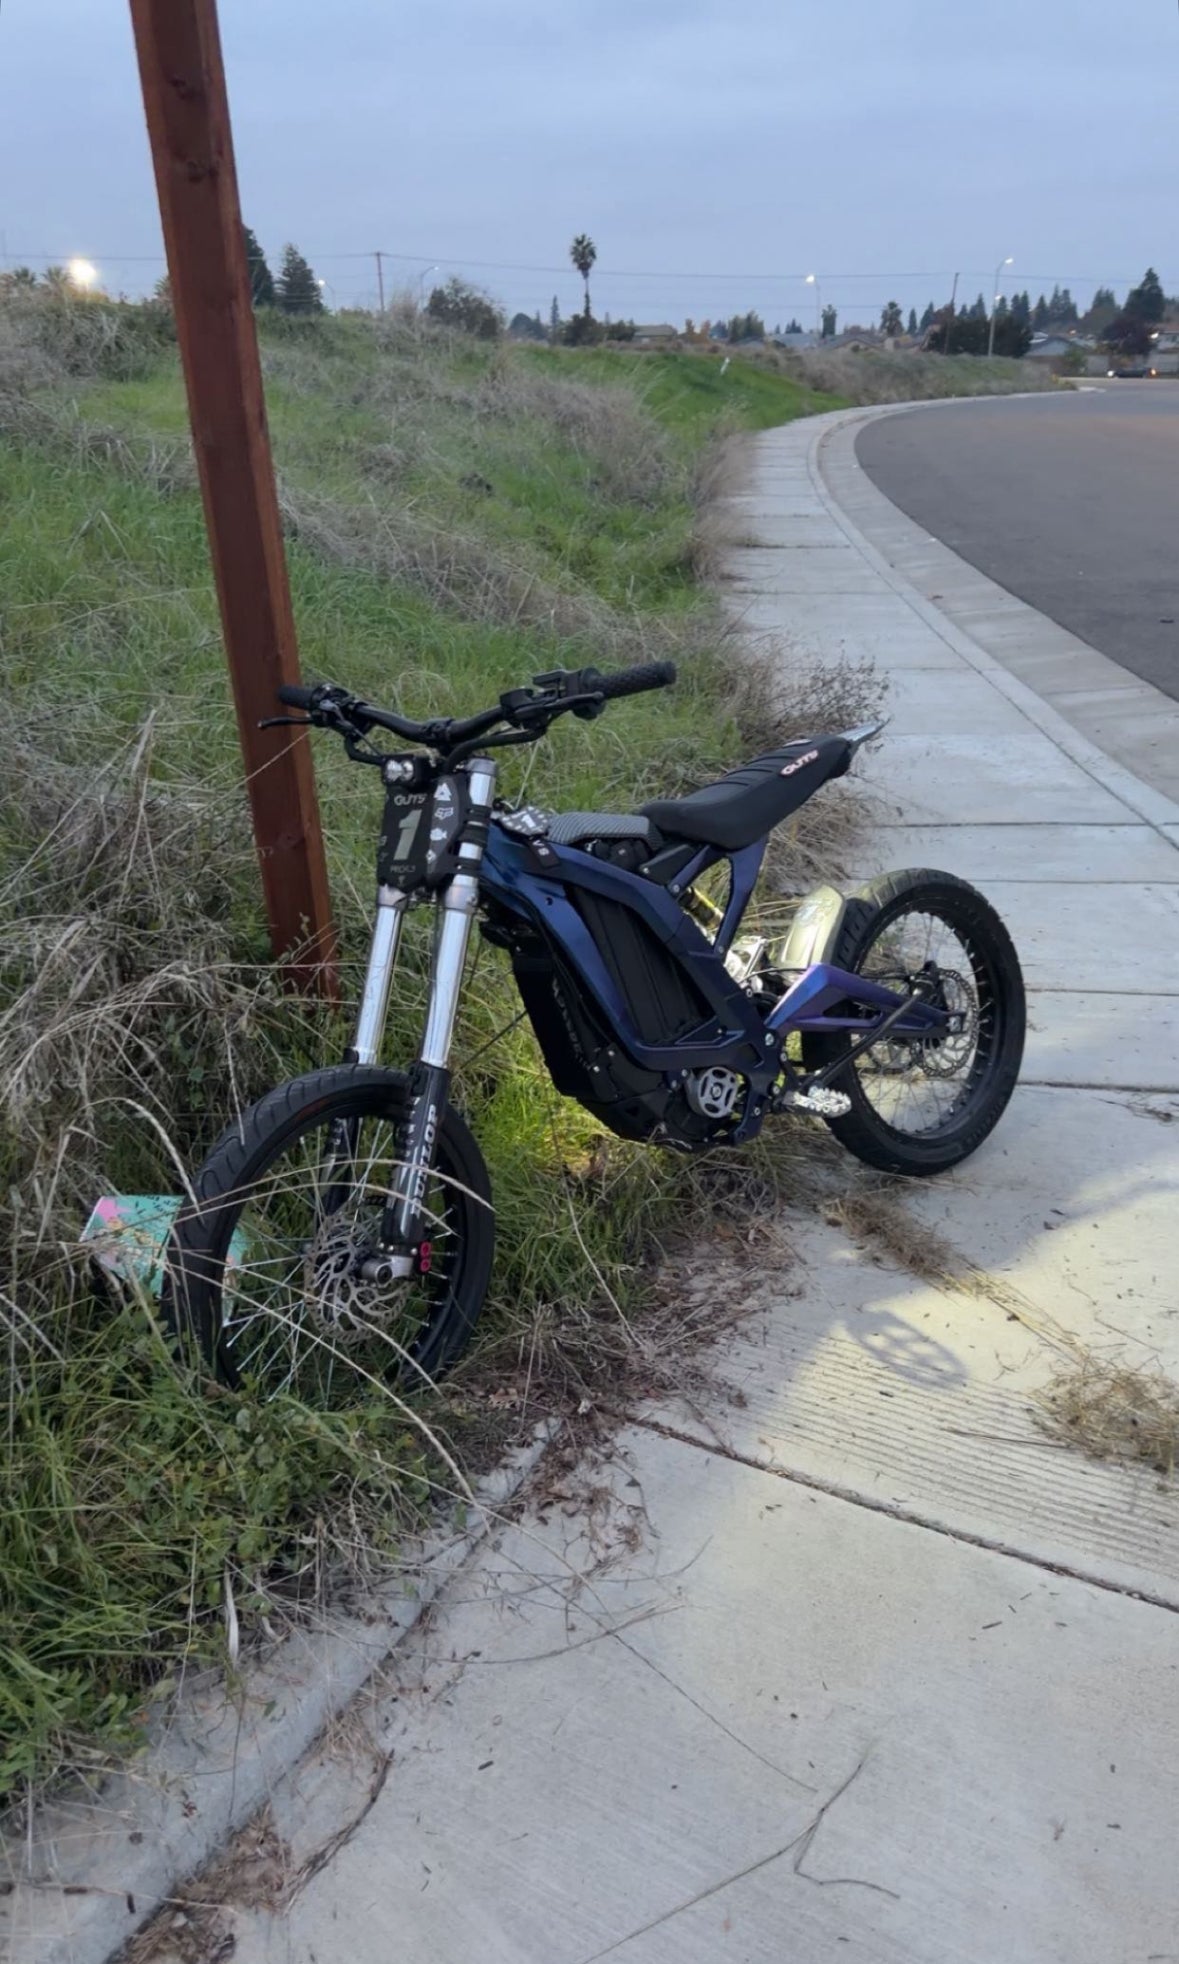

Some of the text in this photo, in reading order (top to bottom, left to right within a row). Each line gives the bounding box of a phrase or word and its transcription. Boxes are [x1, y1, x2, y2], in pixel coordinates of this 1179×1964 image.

[781, 749, 819, 775] GUTS
[394, 793, 427, 806] GUTS
[393, 809, 422, 860] 1
[410, 1104, 437, 1219] DUNLOP
